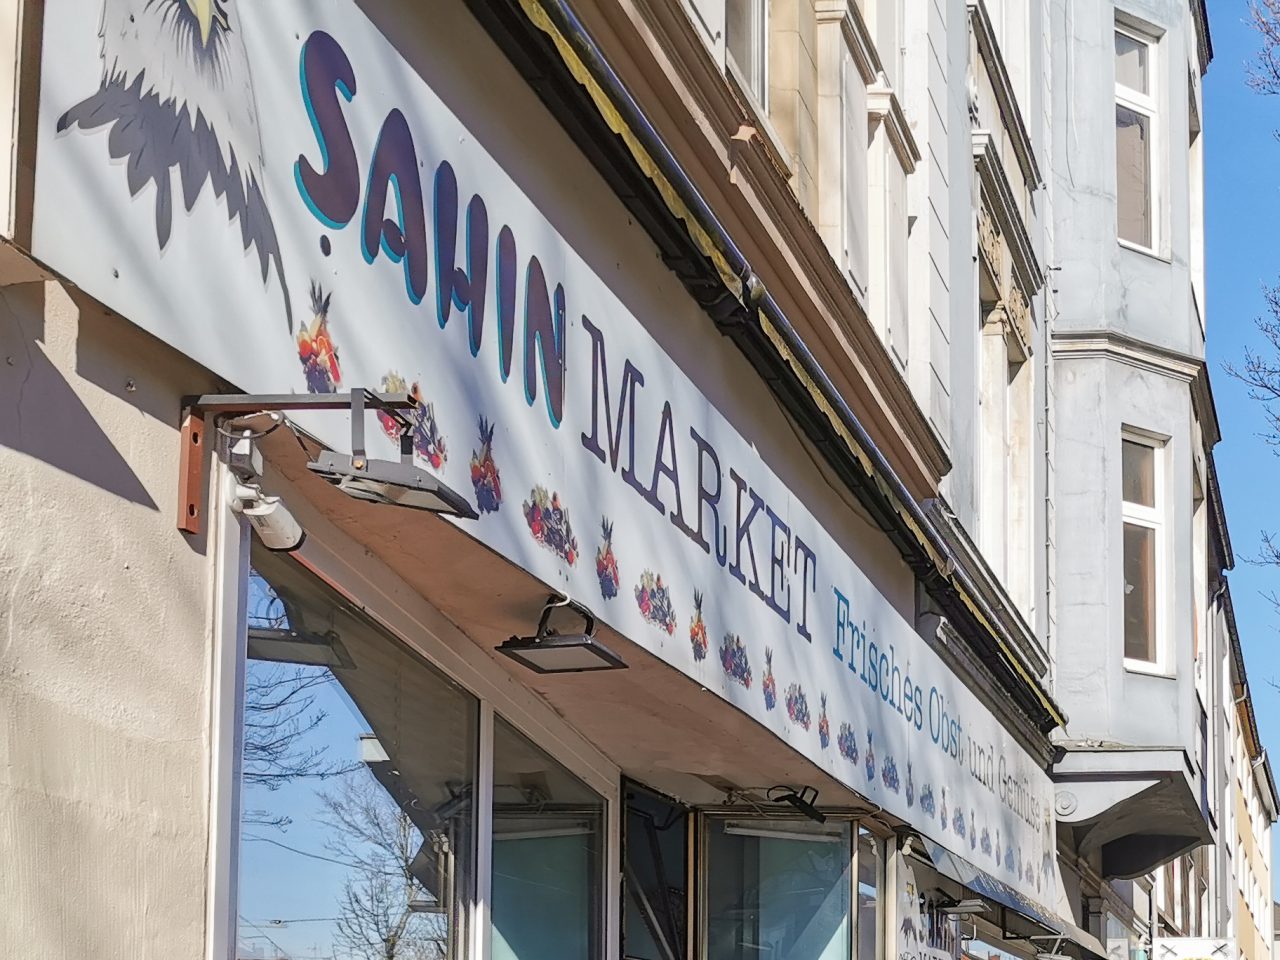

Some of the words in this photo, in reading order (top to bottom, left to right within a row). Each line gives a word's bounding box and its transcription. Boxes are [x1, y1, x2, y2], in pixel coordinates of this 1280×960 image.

[581, 314, 817, 643] MARKET
[832, 586, 923, 731] Frisches
[928, 686, 964, 766] Obst
[967, 735, 995, 794] und
[999, 755, 1040, 833] Gemüse
